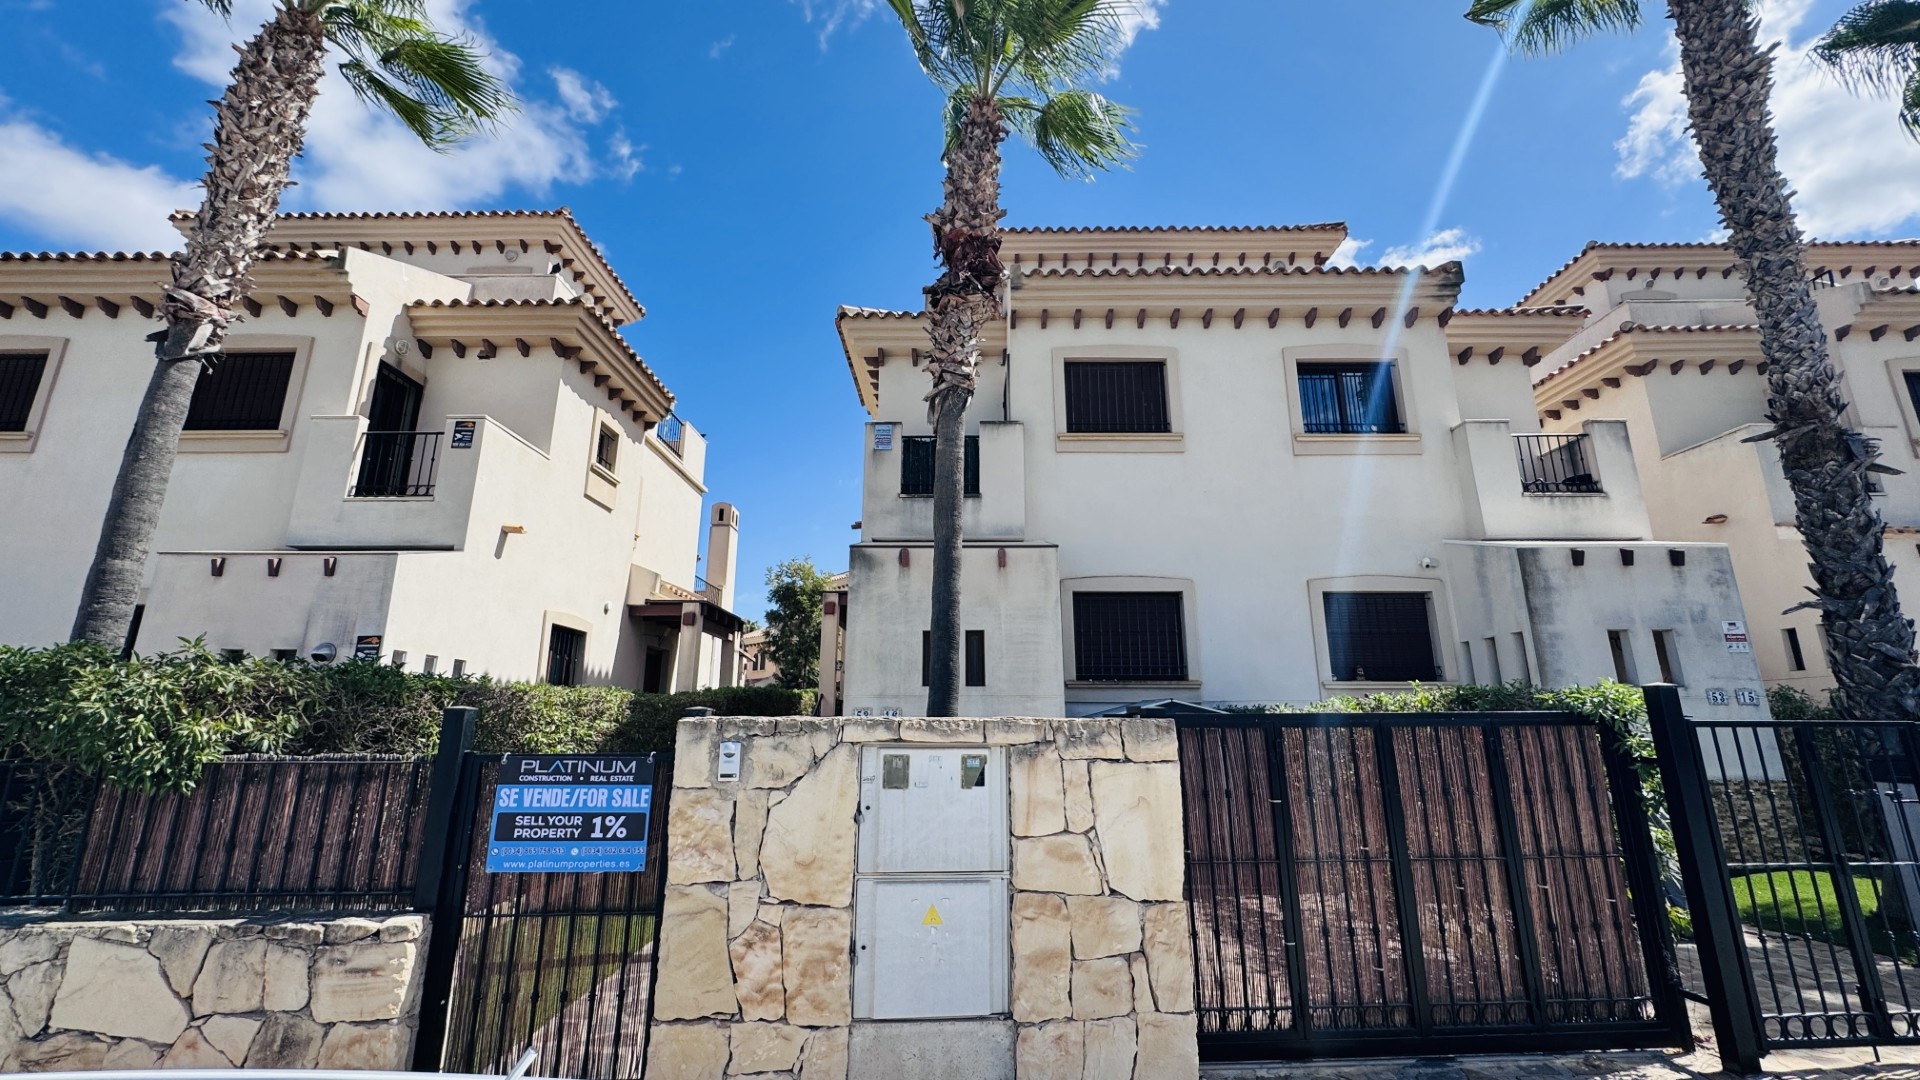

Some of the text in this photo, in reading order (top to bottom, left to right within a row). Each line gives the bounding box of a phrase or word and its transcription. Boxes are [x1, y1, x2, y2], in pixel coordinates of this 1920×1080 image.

[1711, 692, 1755, 703] 53 15
[520, 760, 637, 774] PLATINUM
[499, 788, 650, 808] SE VENDE/FOR SALE
[515, 816, 583, 826] SELL YOUR
[590, 816, 628, 838] 1%
[513, 828, 582, 839] PROPERTY
[501, 847, 523, 857] (0034)
[581, 847, 603, 857] (0034)
[503, 859, 631, 870] www.platinumproperties.es
